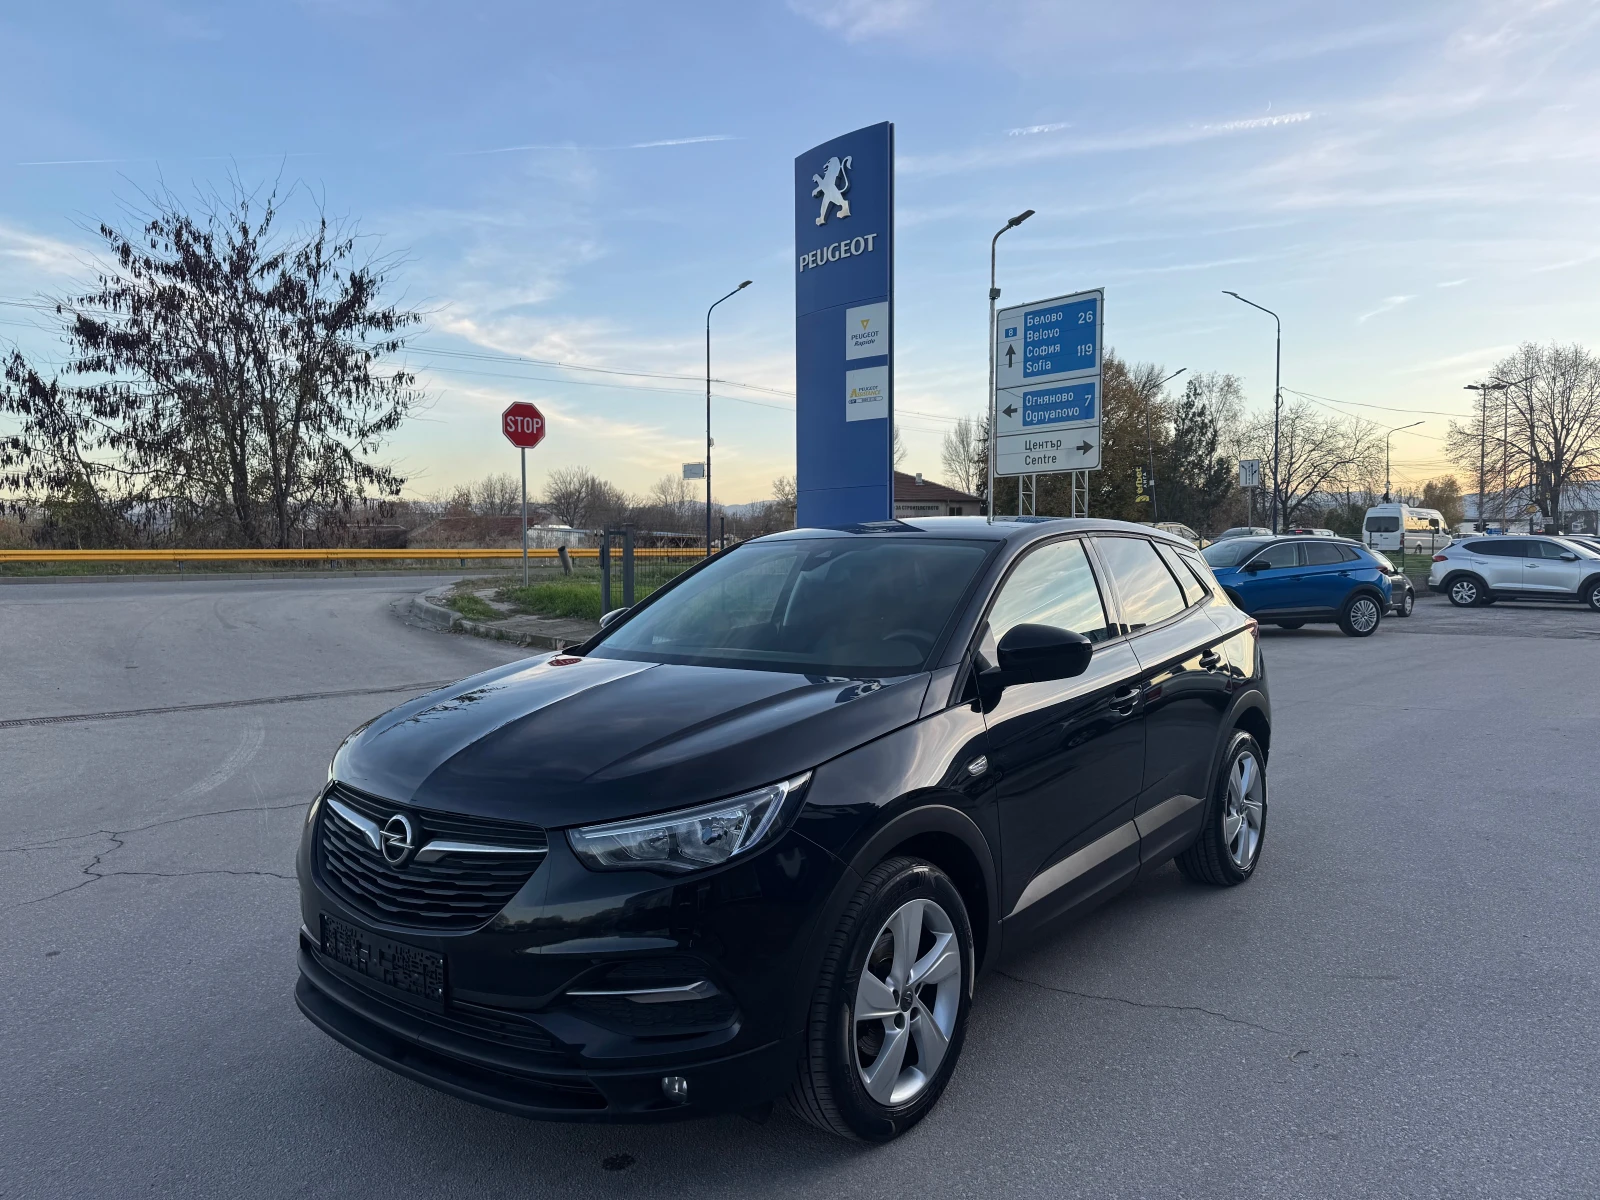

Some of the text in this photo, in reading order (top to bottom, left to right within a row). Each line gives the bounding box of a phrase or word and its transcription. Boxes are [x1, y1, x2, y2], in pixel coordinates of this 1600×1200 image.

[799, 233, 877, 273] PEUGEOT
[1026, 311, 1094, 327] Белово 26
[851, 330, 879, 341] PEUGEOT
[1008, 328, 1014, 337] 8
[1026, 328, 1060, 342] Belovo
[1026, 343, 1093, 358] София 119
[1026, 360, 1052, 373] Sofia
[1025, 392, 1092, 407] Огняново 7
[1025, 407, 1080, 423] Ognyanovo
[506, 415, 542, 434] STOP
[1024, 440, 1062, 452] Център
[1024, 454, 1057, 466] Centre
[1135, 466, 1143, 494] efbet
